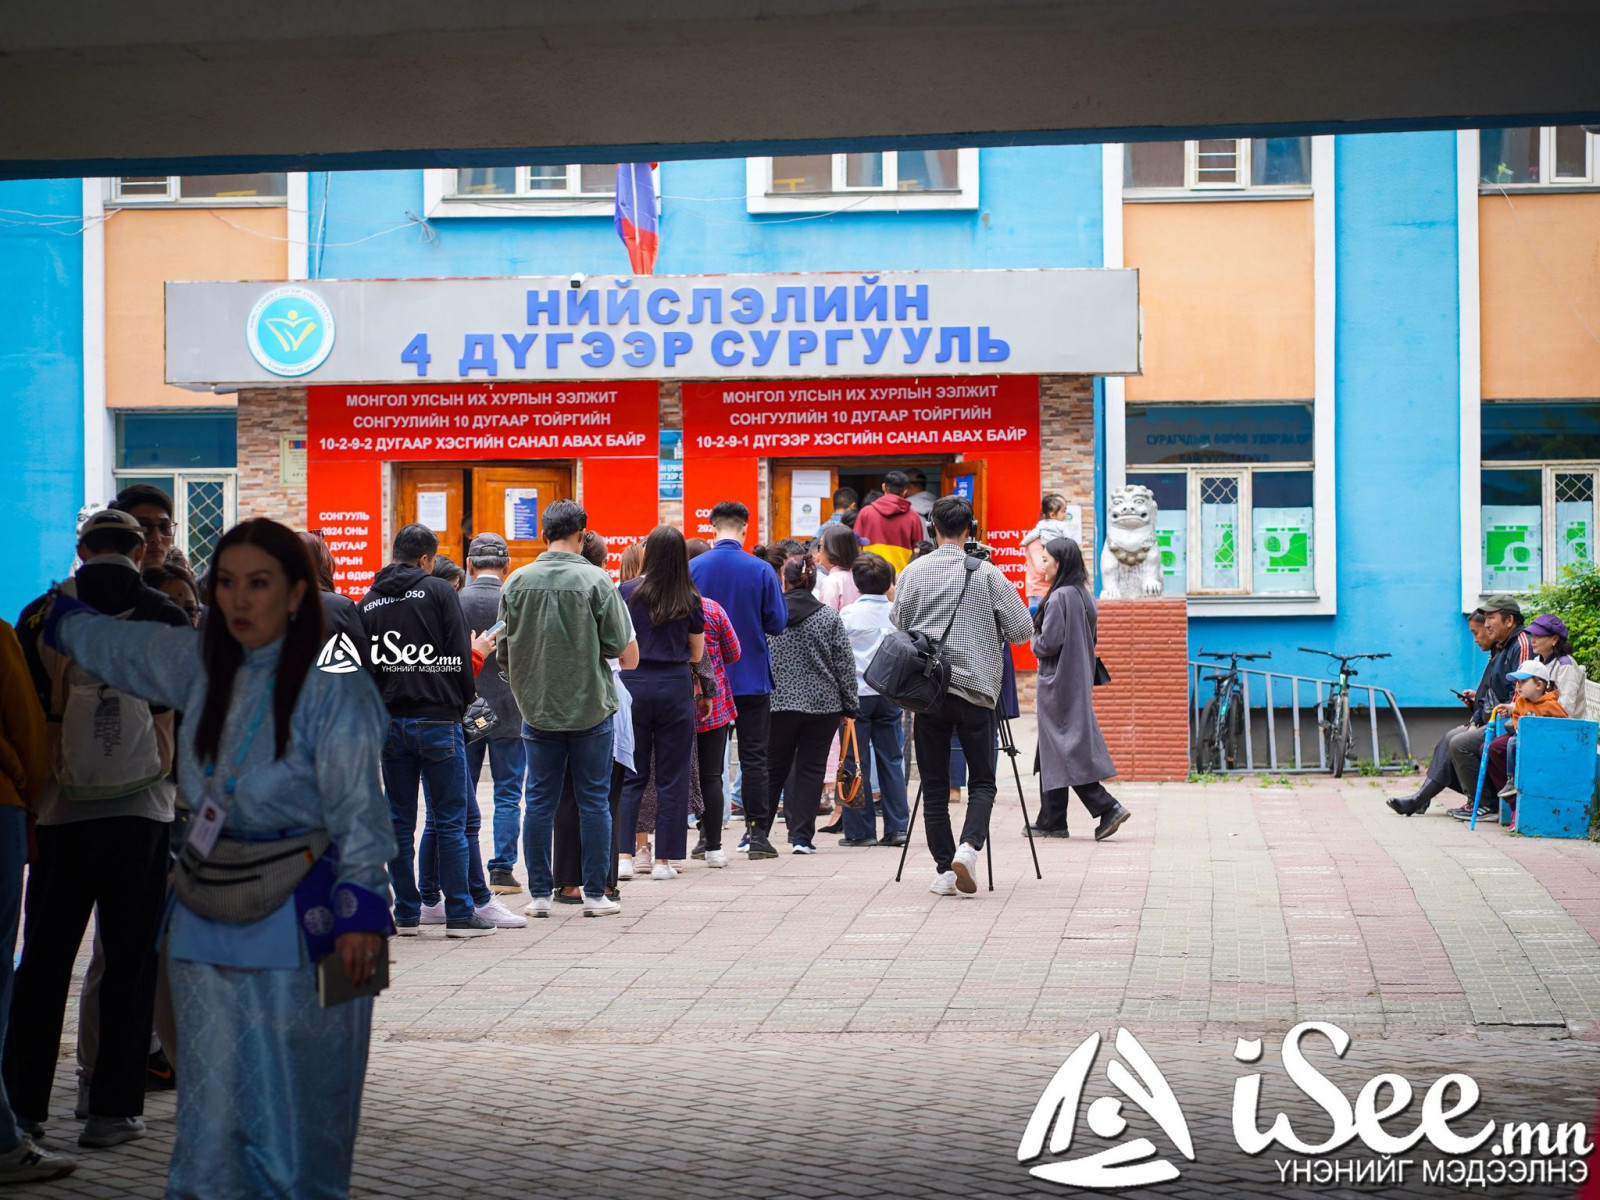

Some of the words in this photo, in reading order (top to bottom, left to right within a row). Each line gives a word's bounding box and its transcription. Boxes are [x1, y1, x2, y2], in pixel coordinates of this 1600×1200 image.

[526, 275, 929, 325] НИЙСЛЭЛИЙН
[401, 333, 431, 376] 4
[459, 331, 693, 376] ДҮГЭЭР
[710, 326, 1011, 367] СУРГУУЛЬ
[347, 395, 406, 406] МОНГОЛ
[412, 395, 463, 405] УЛСЫН
[468, 394, 486, 405] ИХ
[492, 393, 551, 404] ХУРЛЫН
[557, 392, 617, 403] ЭЭЛЖИТ
[724, 391, 784, 402] МОНГОЛ
[789, 390, 841, 401] УЛСЫН
[847, 389, 865, 400] ИХ
[871, 388, 931, 399] ХУРЛЫН
[937, 386, 997, 397] ЭЭЛЖИТ
[354, 414, 449, 427] СОНГУУЛИЙН
[454, 416, 469, 427] 10
[473, 415, 529, 428] ДУГААР
[533, 411, 610, 425] ТОЙРГИЙН
[730, 410, 827, 425] СОНГУУЛИЙН
[833, 412, 847, 422] 10
[851, 410, 908, 424] ДУГААР
[913, 406, 990, 420] ТОЙРГИЙН
[320, 438, 372, 450] 10-2-9-2
[375, 438, 432, 451] ДУГААР
[436, 434, 503, 449] ХЭСГИЙН
[508, 436, 558, 448] САНАЛ
[562, 435, 602, 447] АВАХ
[606, 432, 645, 446] БАЙР
[697, 435, 748, 448] 10-2-9-1
[753, 434, 809, 448] ДҮГЭЭР
[814, 430, 882, 445] ХЭСГИЙН
[887, 431, 938, 443] САНАЛ
[942, 430, 982, 442] АВАХ
[987, 427, 1026, 441] БАЙР
[319, 512, 370, 521] СОНГУУЛЬ
[344, 527, 368, 535] ОНЫ
[697, 524, 713, 532] 202
[330, 541, 367, 551] ДУГААР
[335, 556, 363, 565] АРЫН
[103, 717, 113, 757] NORTH
[112, 717, 121, 745] FACE
